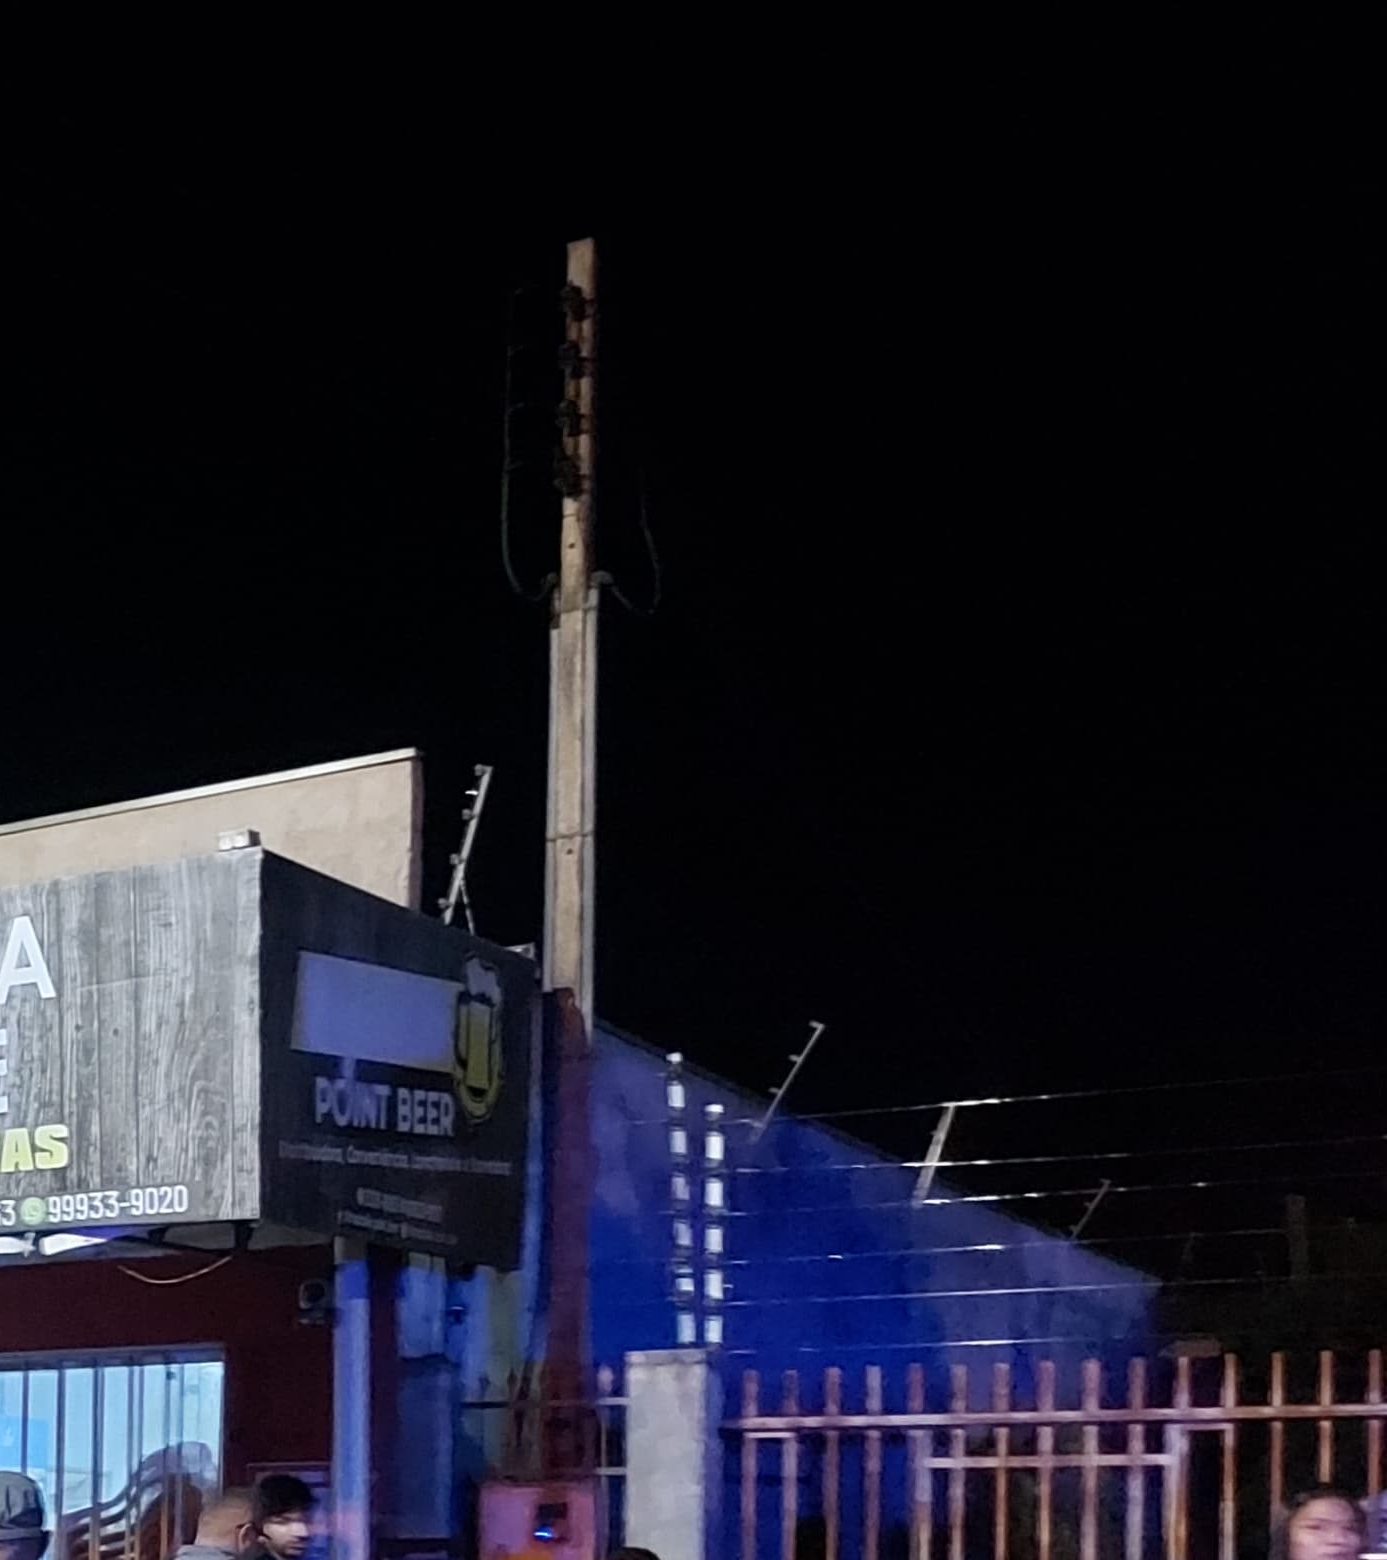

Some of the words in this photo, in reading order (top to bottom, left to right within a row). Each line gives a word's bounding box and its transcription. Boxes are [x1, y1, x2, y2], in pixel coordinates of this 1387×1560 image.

[314, 1076, 392, 1130] POINT
[396, 1087, 455, 1137] BEER
[47, 1185, 190, 1224] 99933-9020
